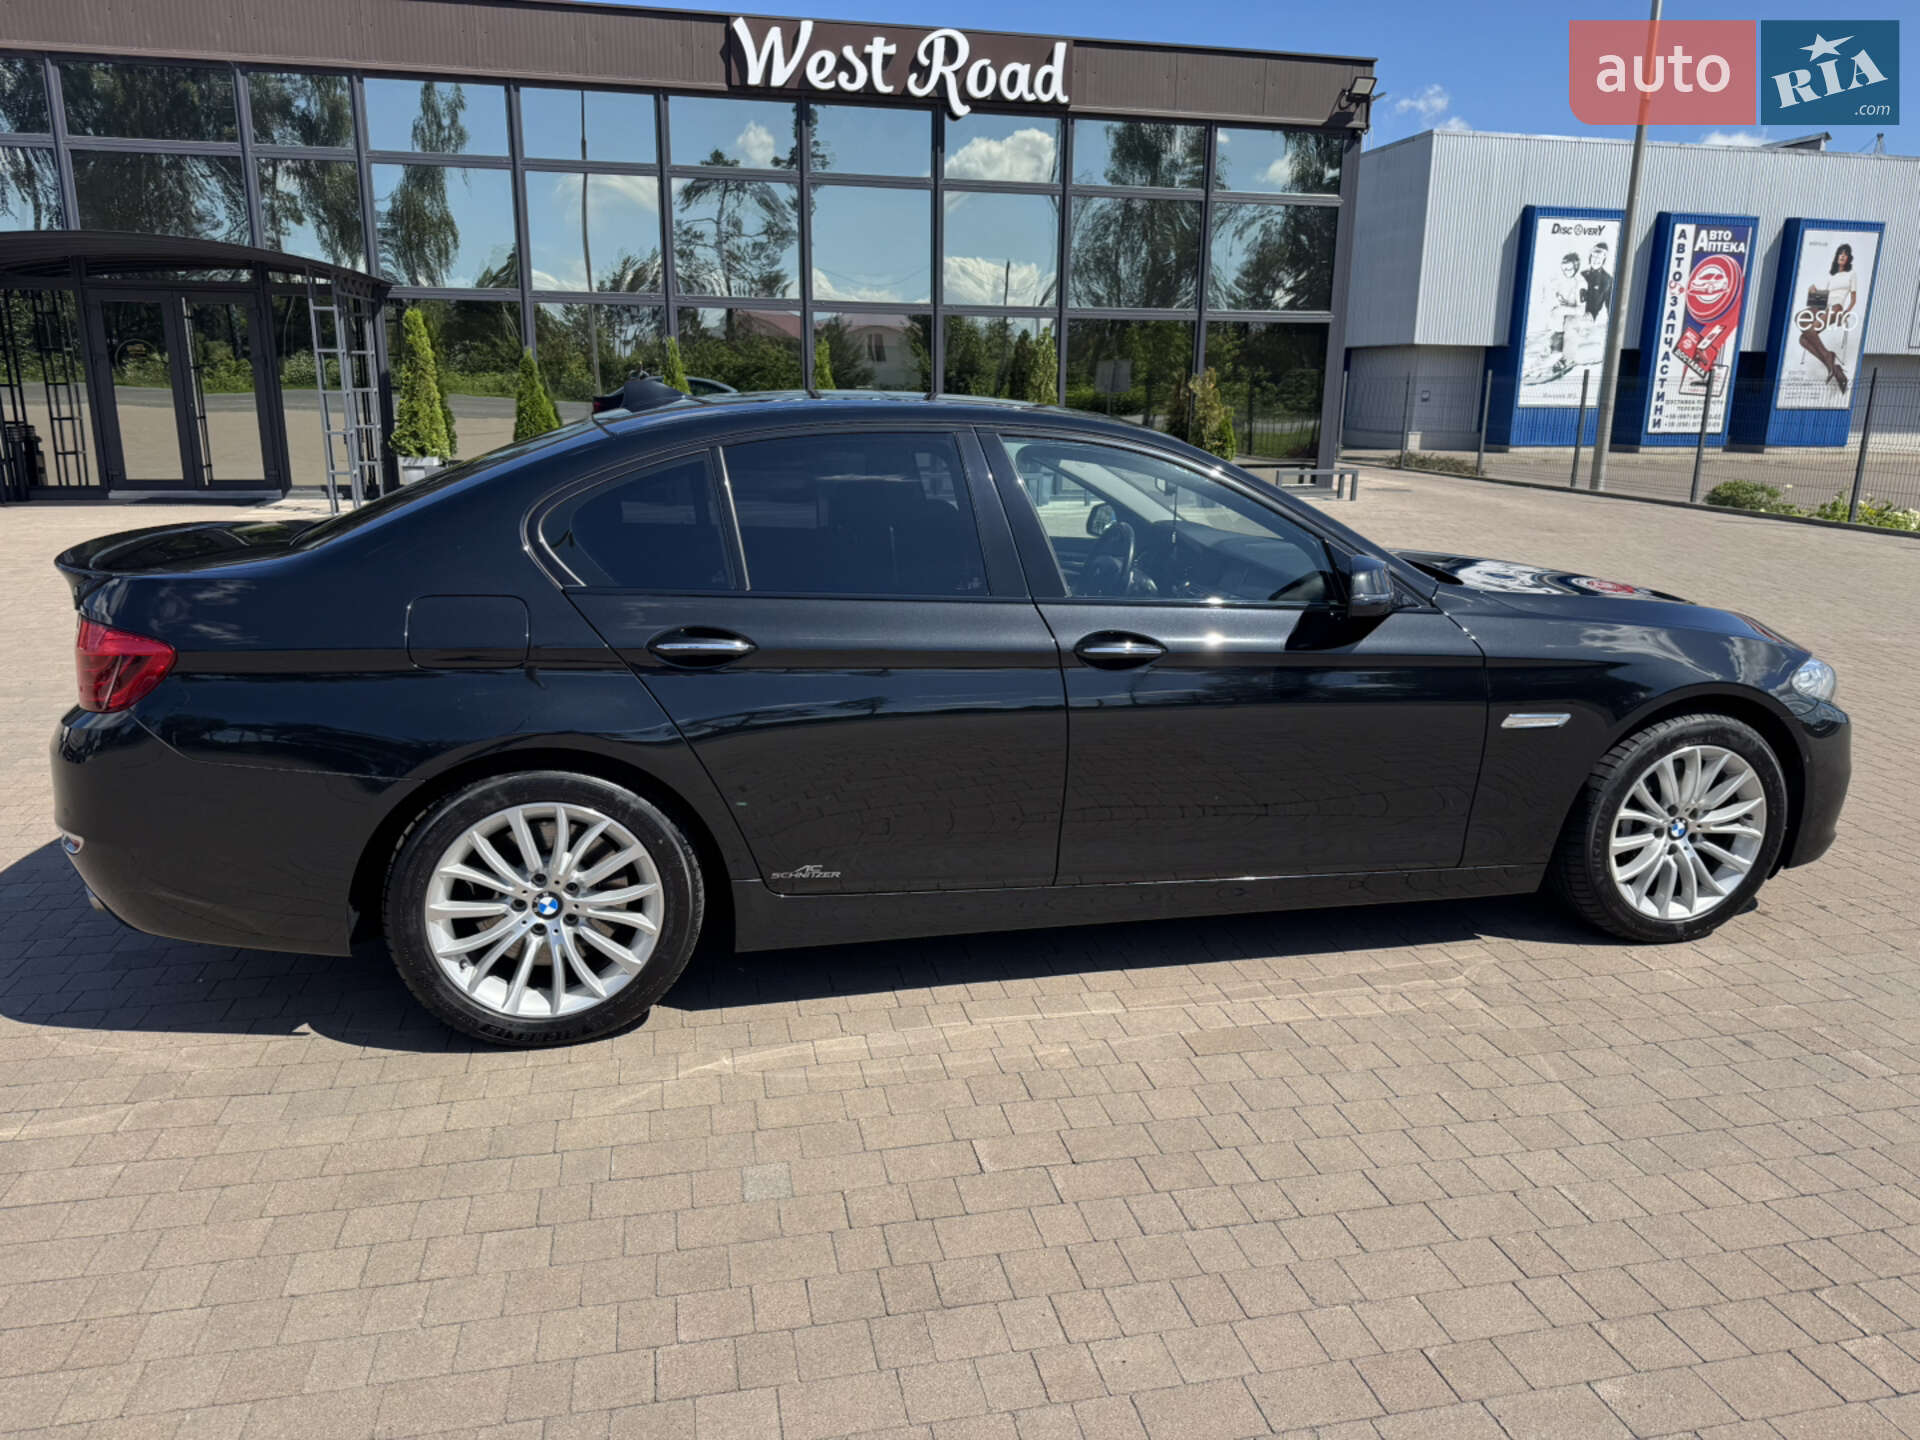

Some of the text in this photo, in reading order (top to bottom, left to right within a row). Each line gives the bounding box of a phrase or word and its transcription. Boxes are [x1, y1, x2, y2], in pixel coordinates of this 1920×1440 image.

[733, 17, 1069, 117] West Road
[1797, 305, 1859, 332] estro
[770, 871, 841, 880] SCHNITZER
